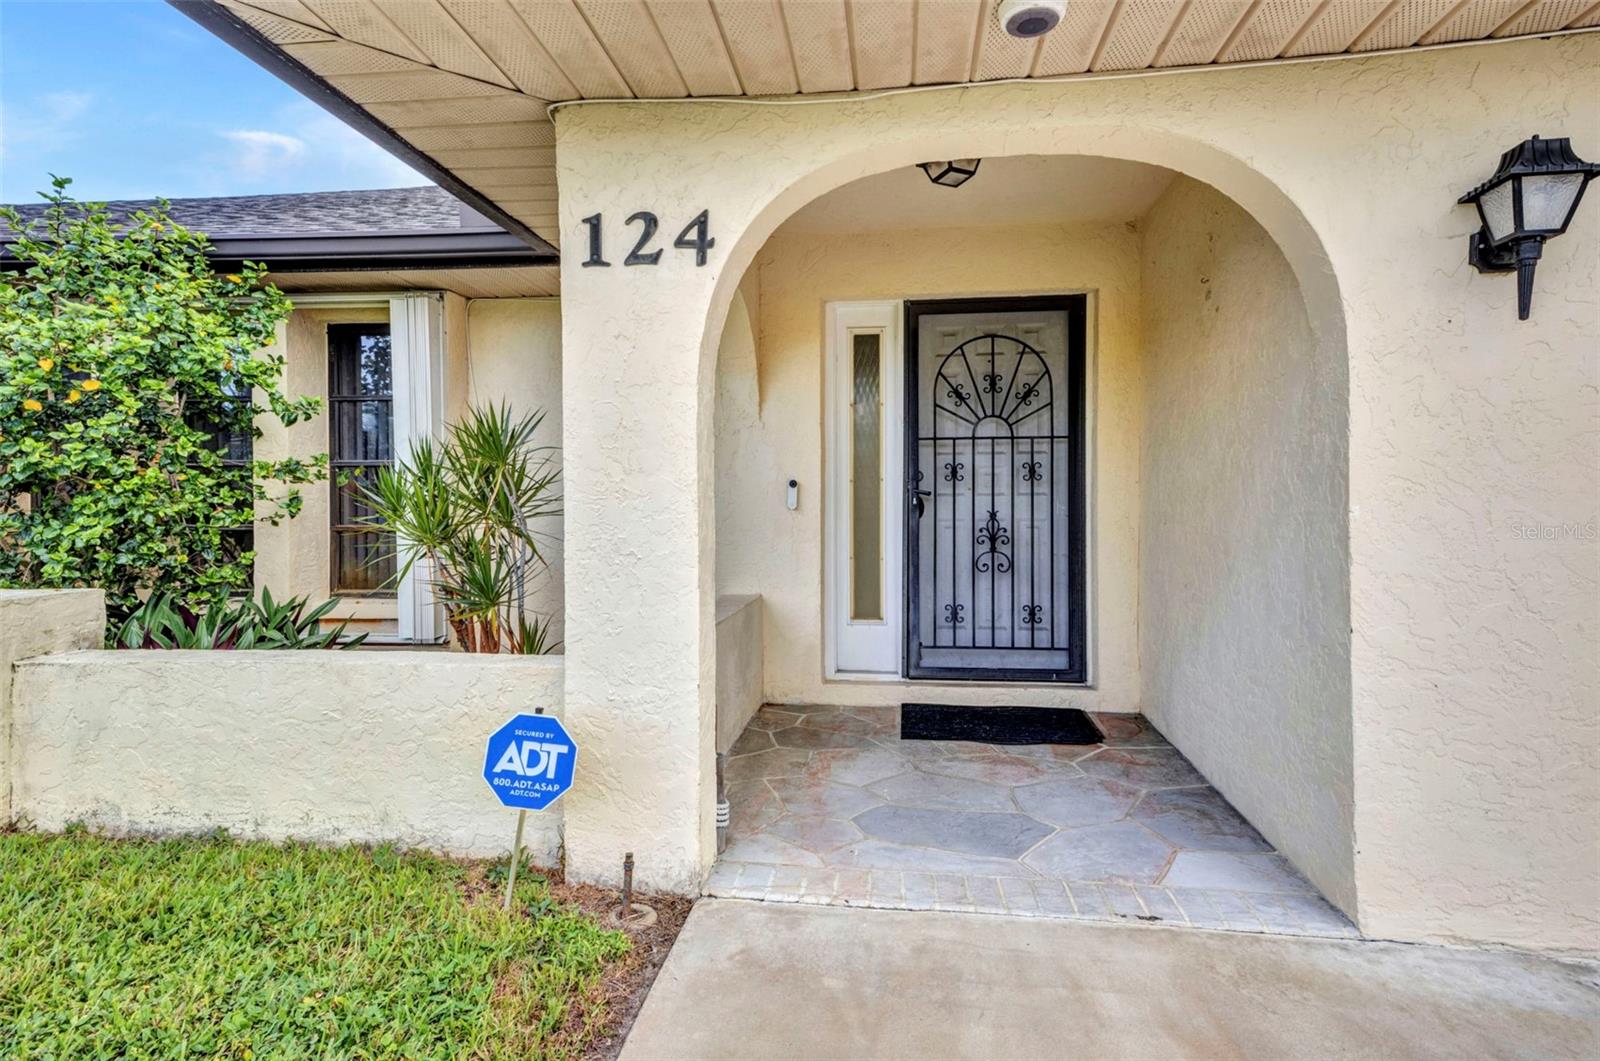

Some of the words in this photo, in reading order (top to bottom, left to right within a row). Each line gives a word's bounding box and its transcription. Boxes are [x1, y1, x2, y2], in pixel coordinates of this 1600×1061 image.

[581, 208, 716, 268] 124
[514, 729, 545, 738] SECURED
[545, 732, 555, 740] BY
[492, 739, 569, 780] ADT
[492, 777, 560, 792] 800.ADT.ASAP
[509, 789, 541, 798] ADT.COM
